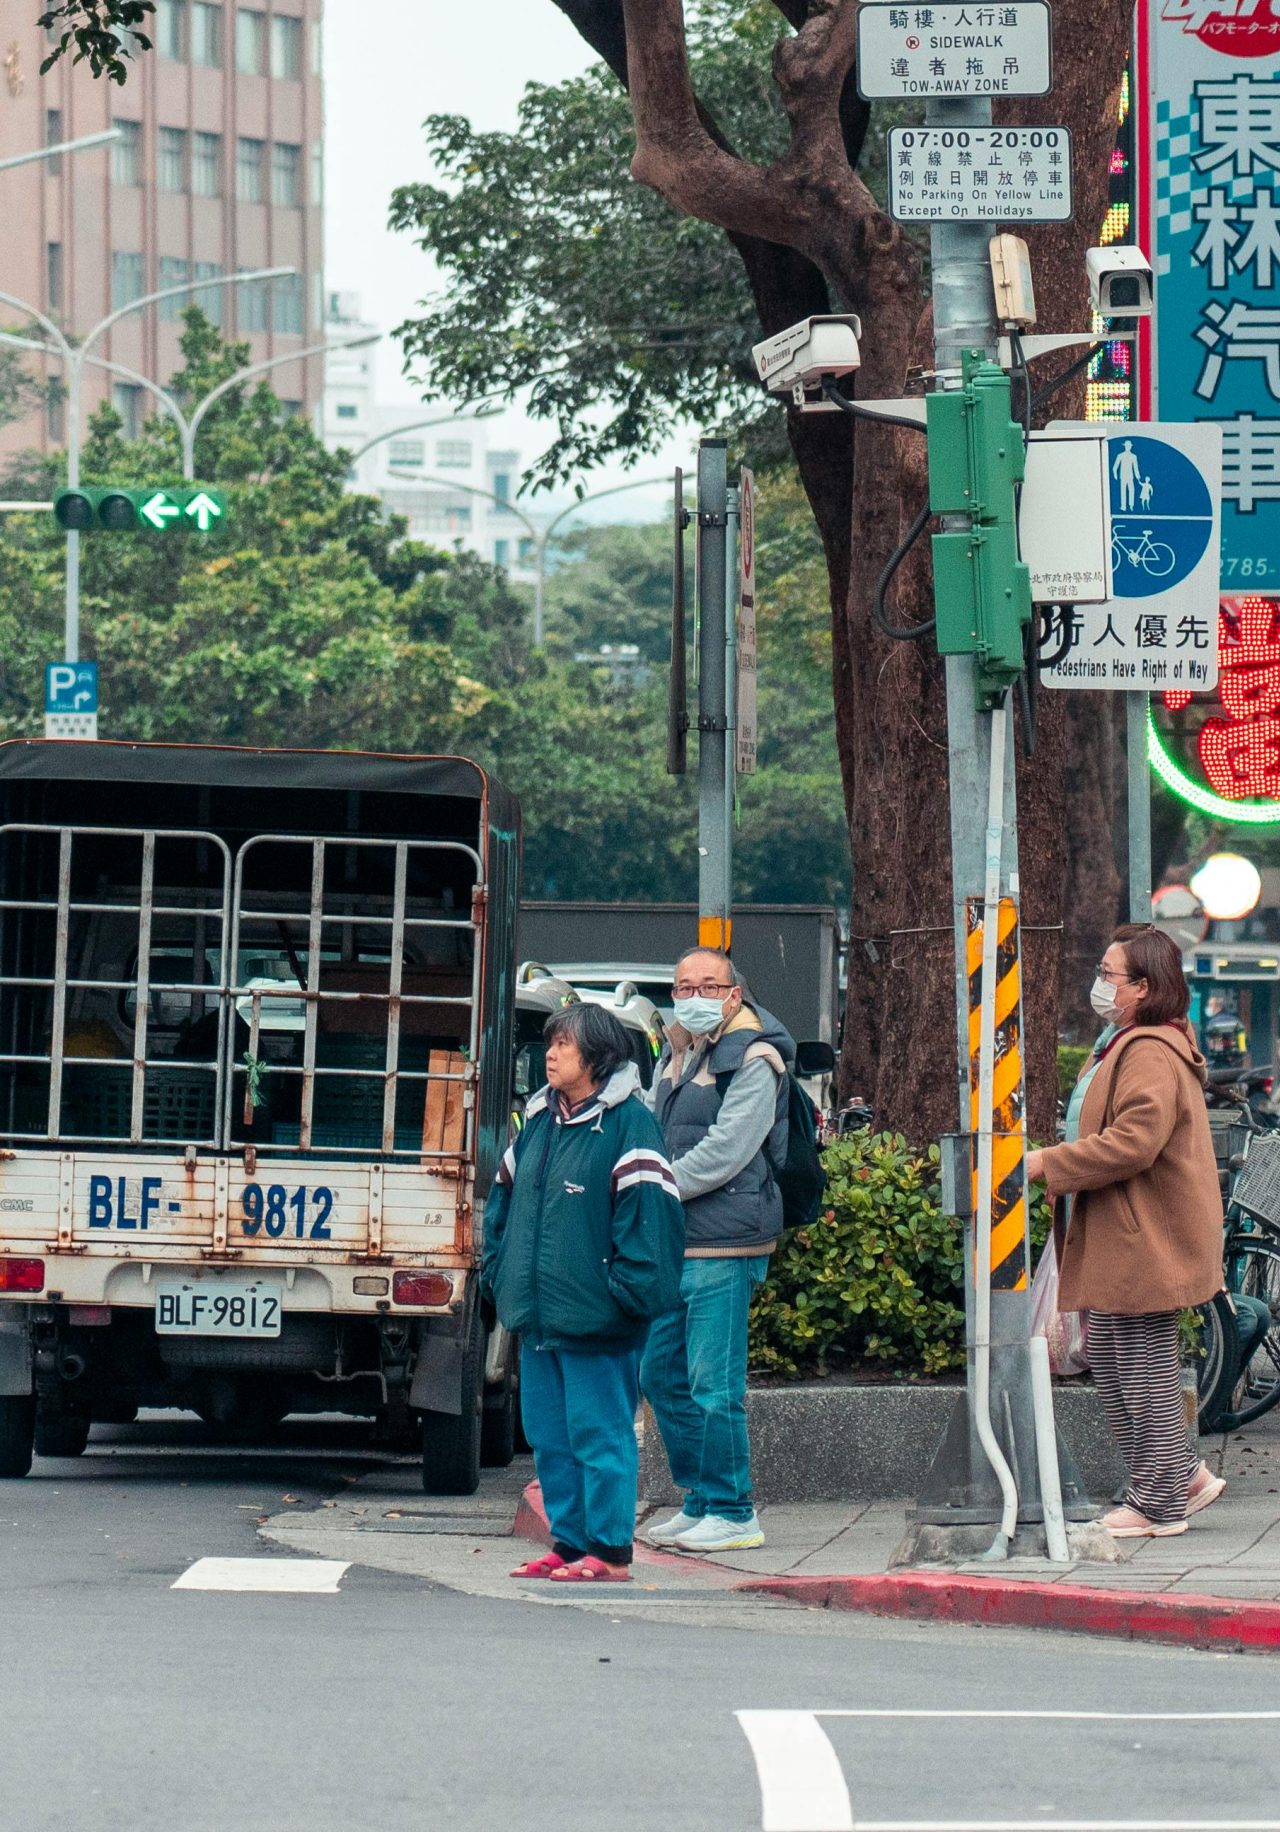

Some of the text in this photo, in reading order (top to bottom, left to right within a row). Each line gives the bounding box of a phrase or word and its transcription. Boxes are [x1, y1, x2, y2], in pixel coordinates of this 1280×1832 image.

[930, 35, 1003, 49] SIDEWALK
[890, 57, 1019, 77] 違者拖吊
[902, 79, 1009, 93] TOW-AWAY ZONE
[901, 131, 1059, 148] 07:00-20:00
[898, 151, 1062, 167] 黃線禁止停車
[898, 170, 1063, 187] 例假日開放停車
[899, 189, 1063, 202] No Parking On Yellow Line
[899, 205, 1033, 218] Except On Holidays
[1029, 571, 1103, 584] 北市政府警察局
[1051, 613, 1209, 649] 行人優先
[1112, 659, 1136, 678] Have
[1142, 659, 1167, 684] Right
[1173, 659, 1184, 679] of
[1188, 660, 1208, 684] Way
[50, 666, 76, 701] P
[0, 1198, 33, 1211] CMC
[241, 1182, 334, 1240] 9812
